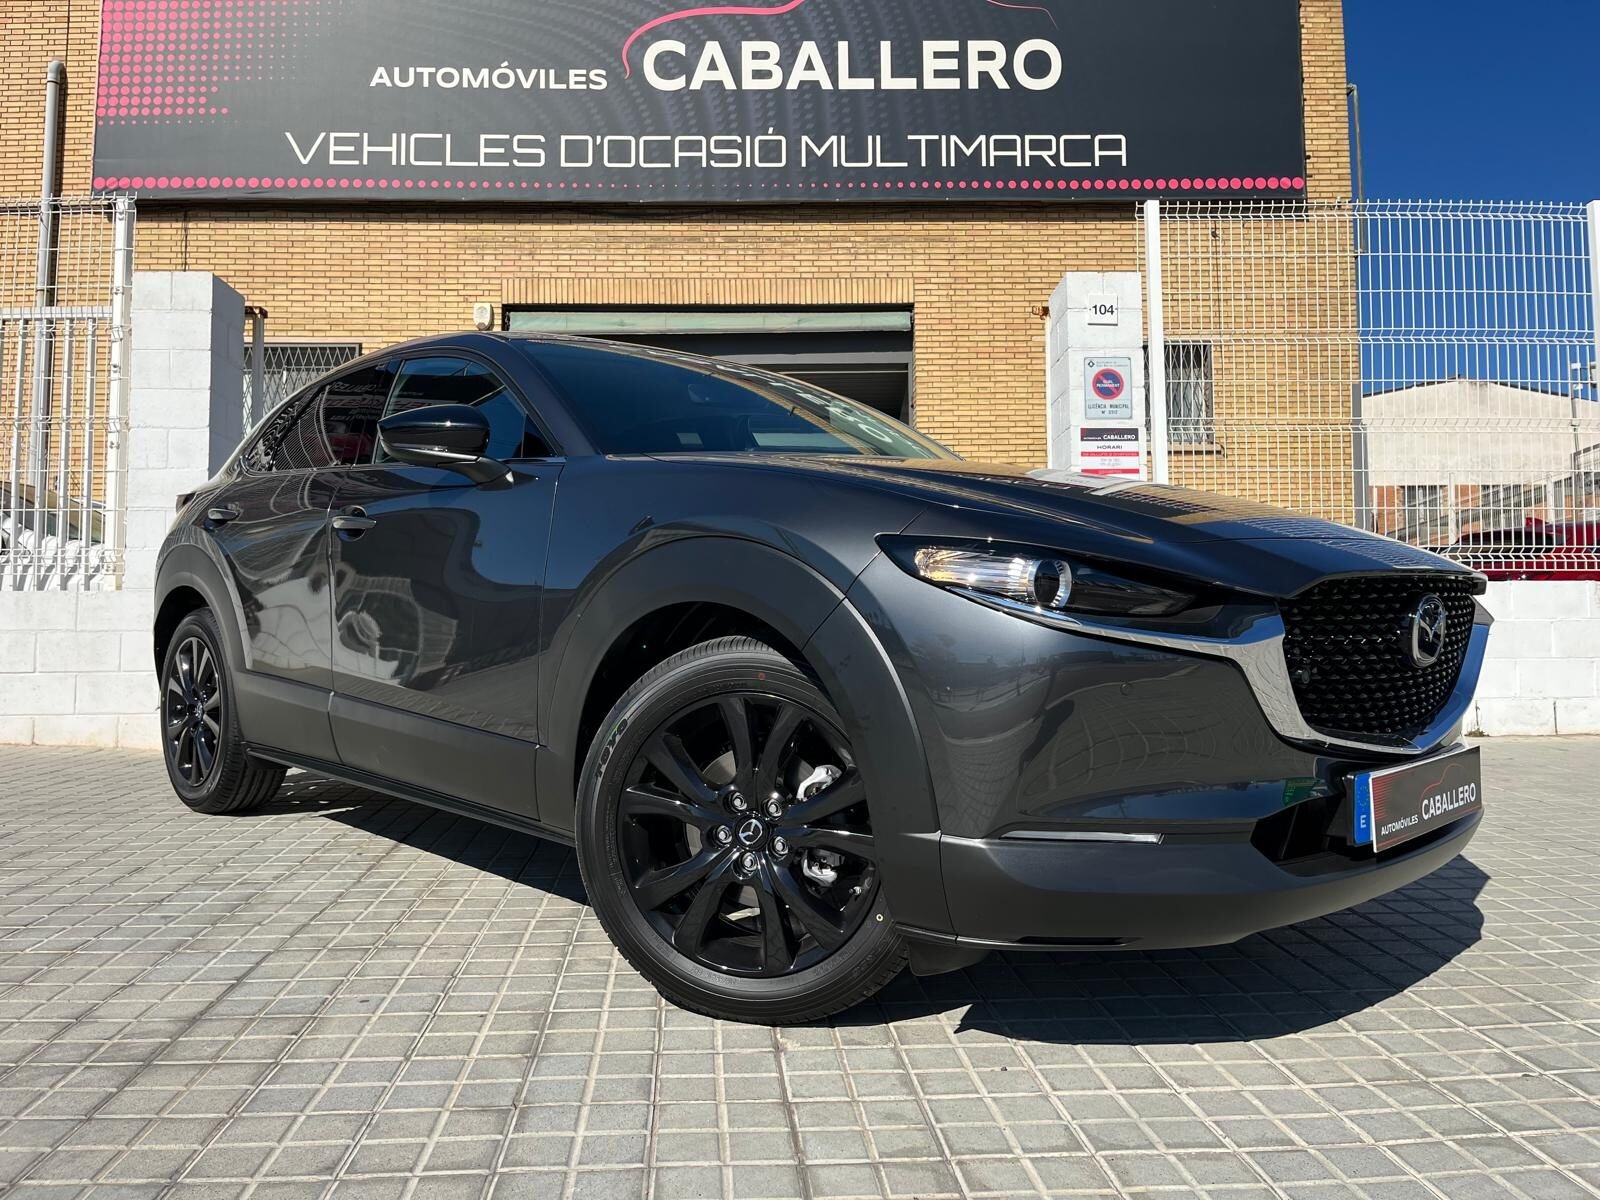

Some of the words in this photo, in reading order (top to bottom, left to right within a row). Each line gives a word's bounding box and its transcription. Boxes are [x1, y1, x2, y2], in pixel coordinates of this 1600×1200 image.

[369, 61, 608, 91] AUTOMÓVILES
[643, 39, 1062, 91] CABALLERO
[284, 131, 546, 167] VEHICLES
[560, 127, 787, 168] D'OCASIÓ
[801, 134, 1127, 168] MULTIMARCA
[1092, 304, 1115, 315] 104
[1360, 815, 1367, 829] E
[1381, 814, 1419, 836] AUTOMÓVILES
[1421, 782, 1477, 820] CABALLERO
